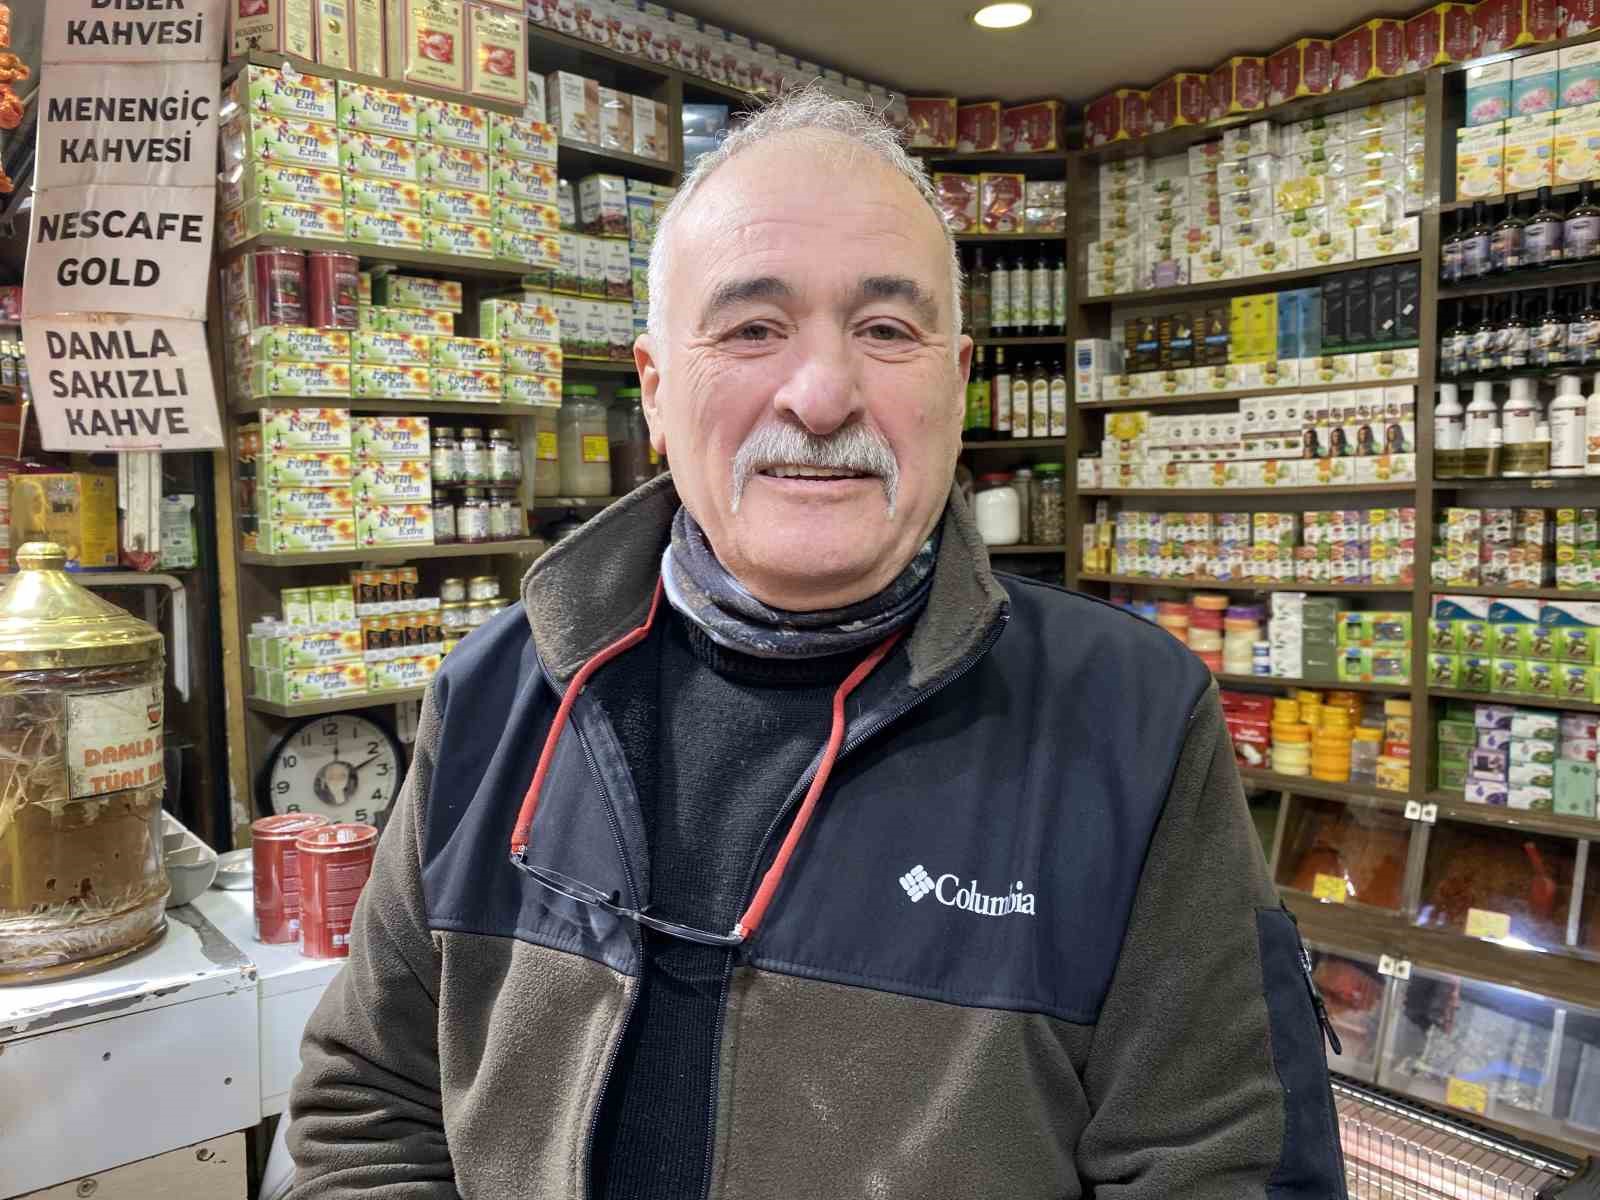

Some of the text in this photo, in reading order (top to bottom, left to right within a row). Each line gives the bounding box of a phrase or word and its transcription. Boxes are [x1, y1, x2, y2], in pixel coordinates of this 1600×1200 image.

[67, 13, 202, 45] KAHVESİ
[48, 90, 210, 127] MENENGİÇ
[60, 130, 190, 163] KAHVESİ
[37, 210, 203, 243] NESCAFE
[57, 258, 160, 287] GOLD
[45, 329, 176, 360] DAMLA
[50, 368, 188, 398] SAKIZLI
[65, 407, 190, 436] KAHVE
[288, 419, 331, 432] Form
[372, 429, 411, 441] Form
[374, 472, 412, 484] Form
[379, 515, 416, 527] Form
[322, 723, 338, 736] 12
[353, 727, 358, 738] 1
[302, 733, 312, 747] 11
[367, 742, 379, 755] 2
[282, 756, 297, 768] 10
[376, 763, 388, 776] 3
[276, 782, 290, 794] 9
[371, 788, 383, 801] 4
[355, 809, 368, 822] 5
[935, 873, 1035, 916] Columbia
